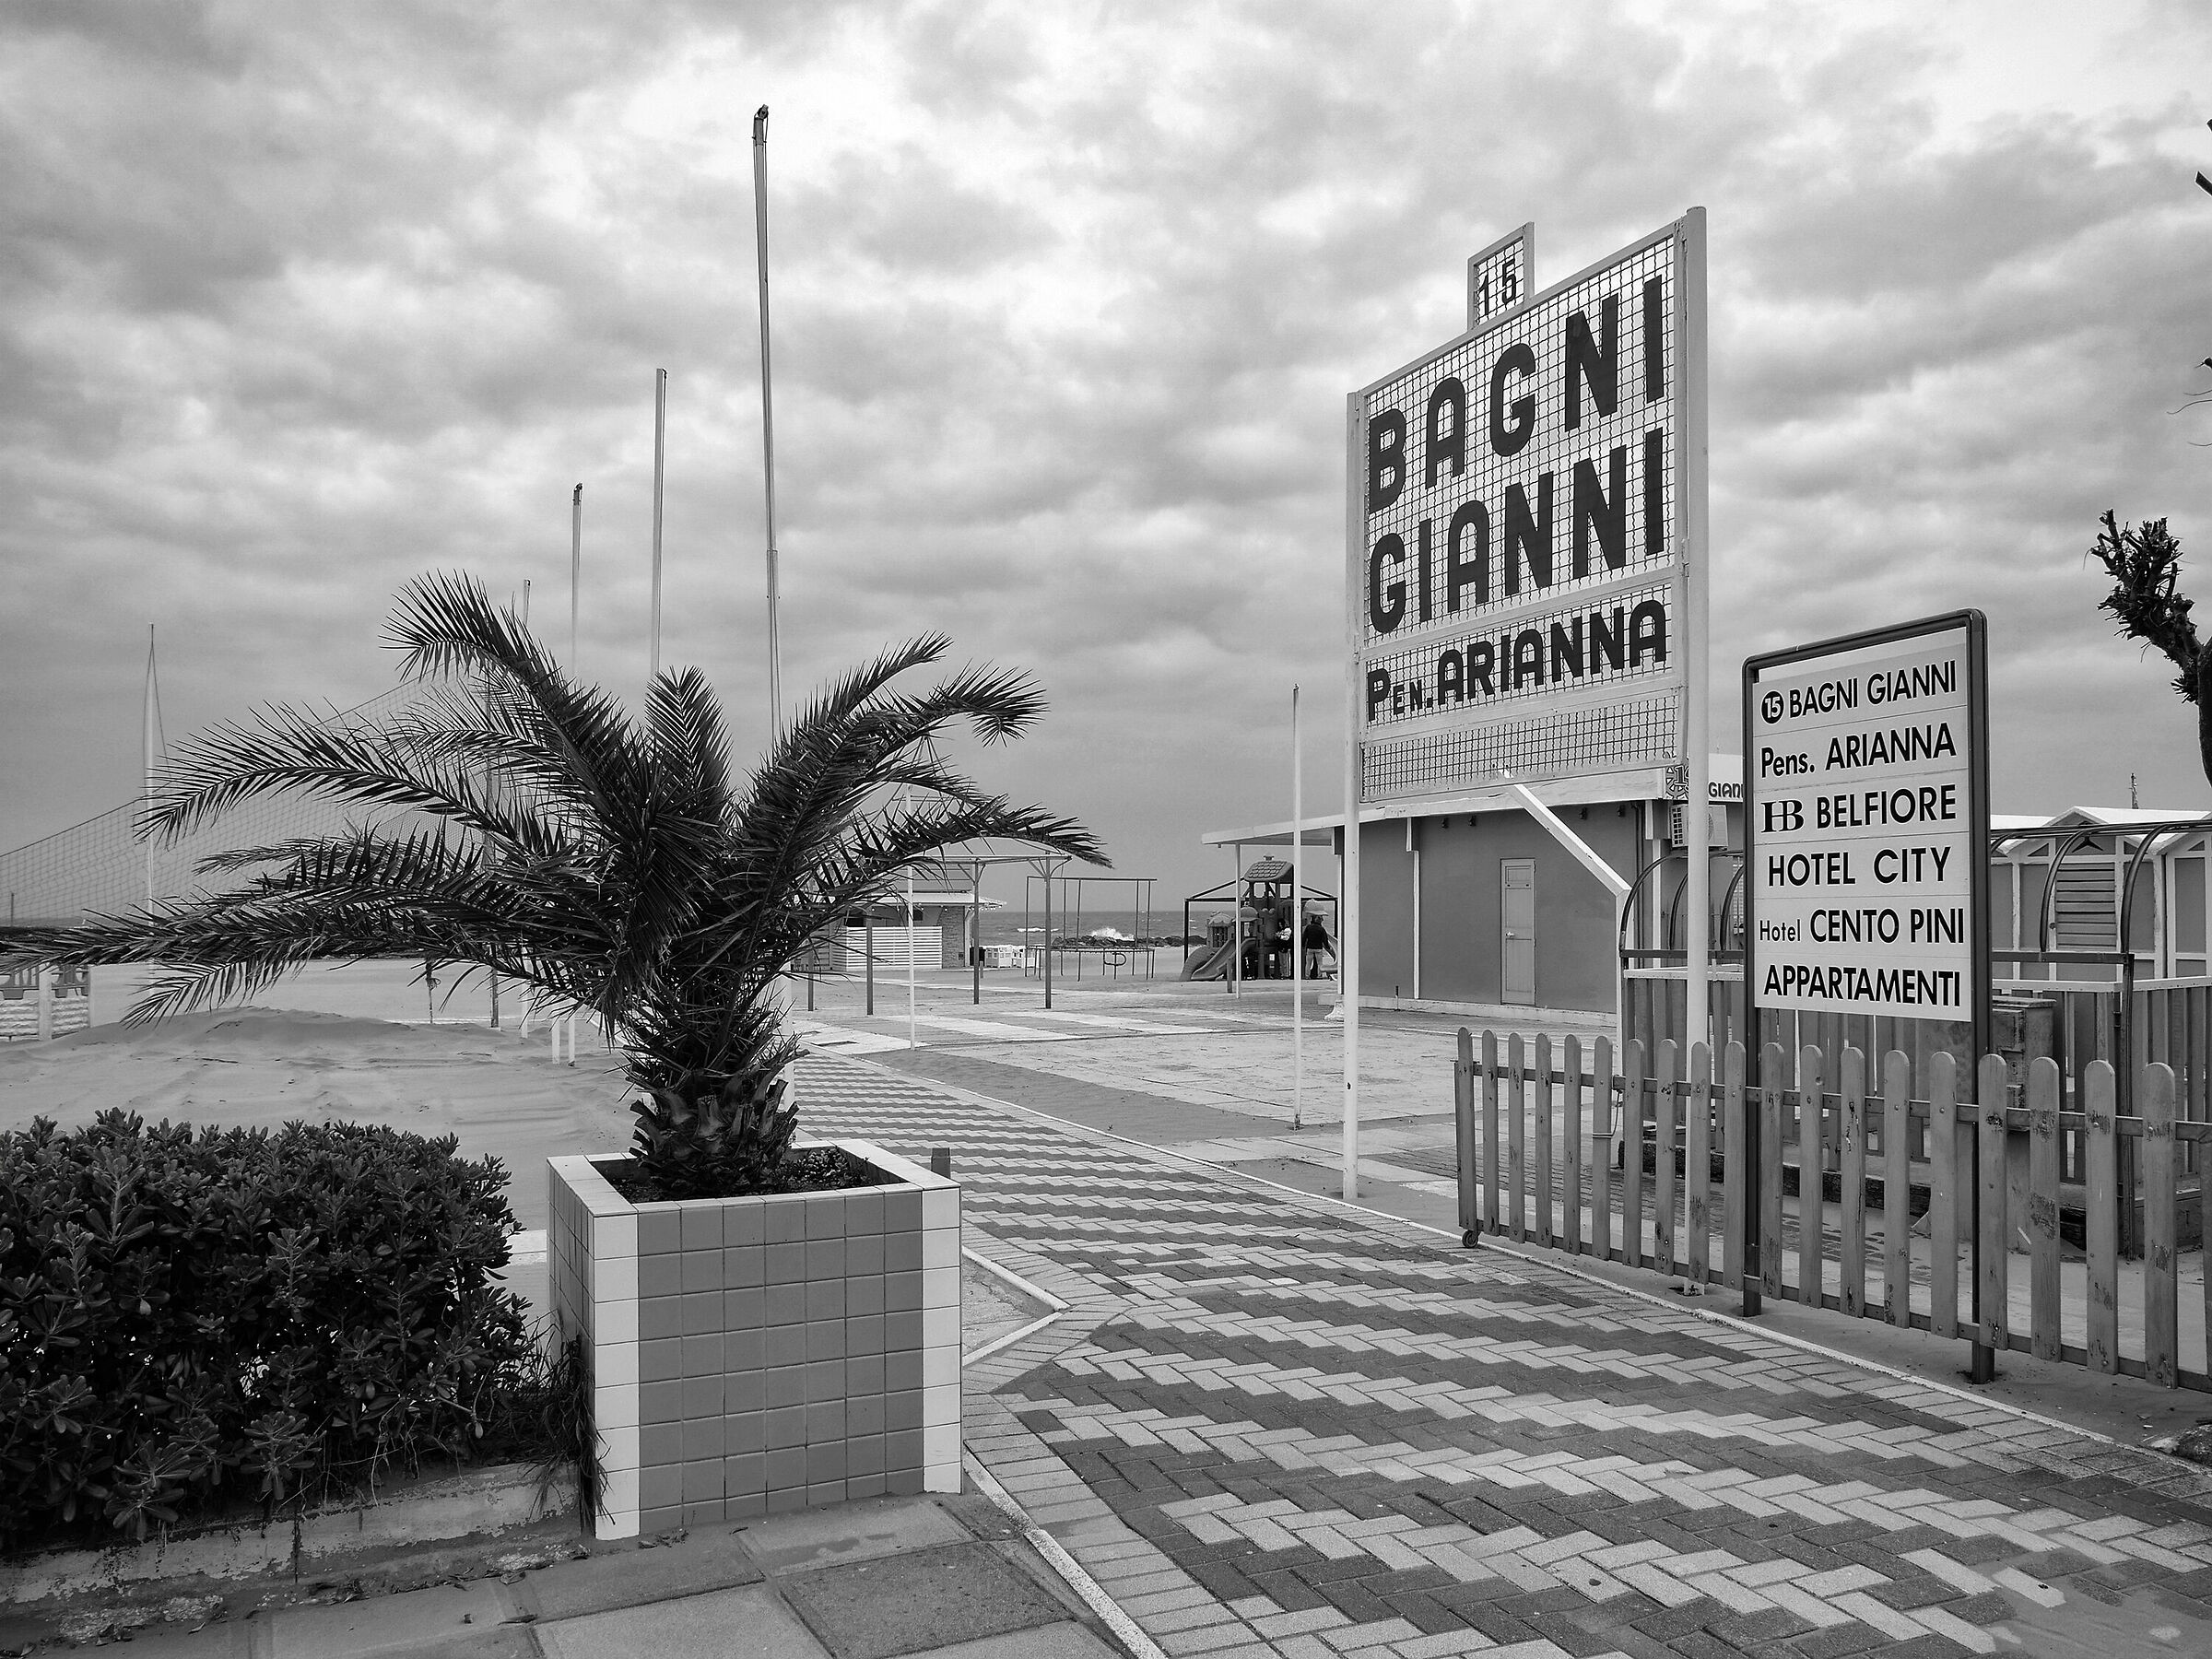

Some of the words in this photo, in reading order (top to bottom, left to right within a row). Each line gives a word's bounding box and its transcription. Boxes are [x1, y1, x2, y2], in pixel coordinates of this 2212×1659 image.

[1477, 259, 1517, 315] 15
[1369, 275, 1664, 514] BAGNI
[1369, 428, 1665, 635] GIANNI
[1438, 600, 1667, 705] ARIANNA
[1762, 693, 1783, 722] 15
[1790, 677, 1857, 719] BAGNI
[1867, 660, 1956, 705] GIANNI
[1761, 747, 1815, 778] Pens.
[1825, 723, 1957, 771] ARIANNA
[1760, 800, 1804, 832] HB
[1817, 784, 1956, 830] BELFIORE
[1769, 852, 1855, 887] HOTEL
[1874, 847, 1951, 884] CITY
[1759, 919, 1801, 943] Hotel
[1810, 909, 1900, 943] CENTO
[1911, 908, 1964, 944] PINI
[1764, 964, 1960, 1007] APPARTAMENTI
